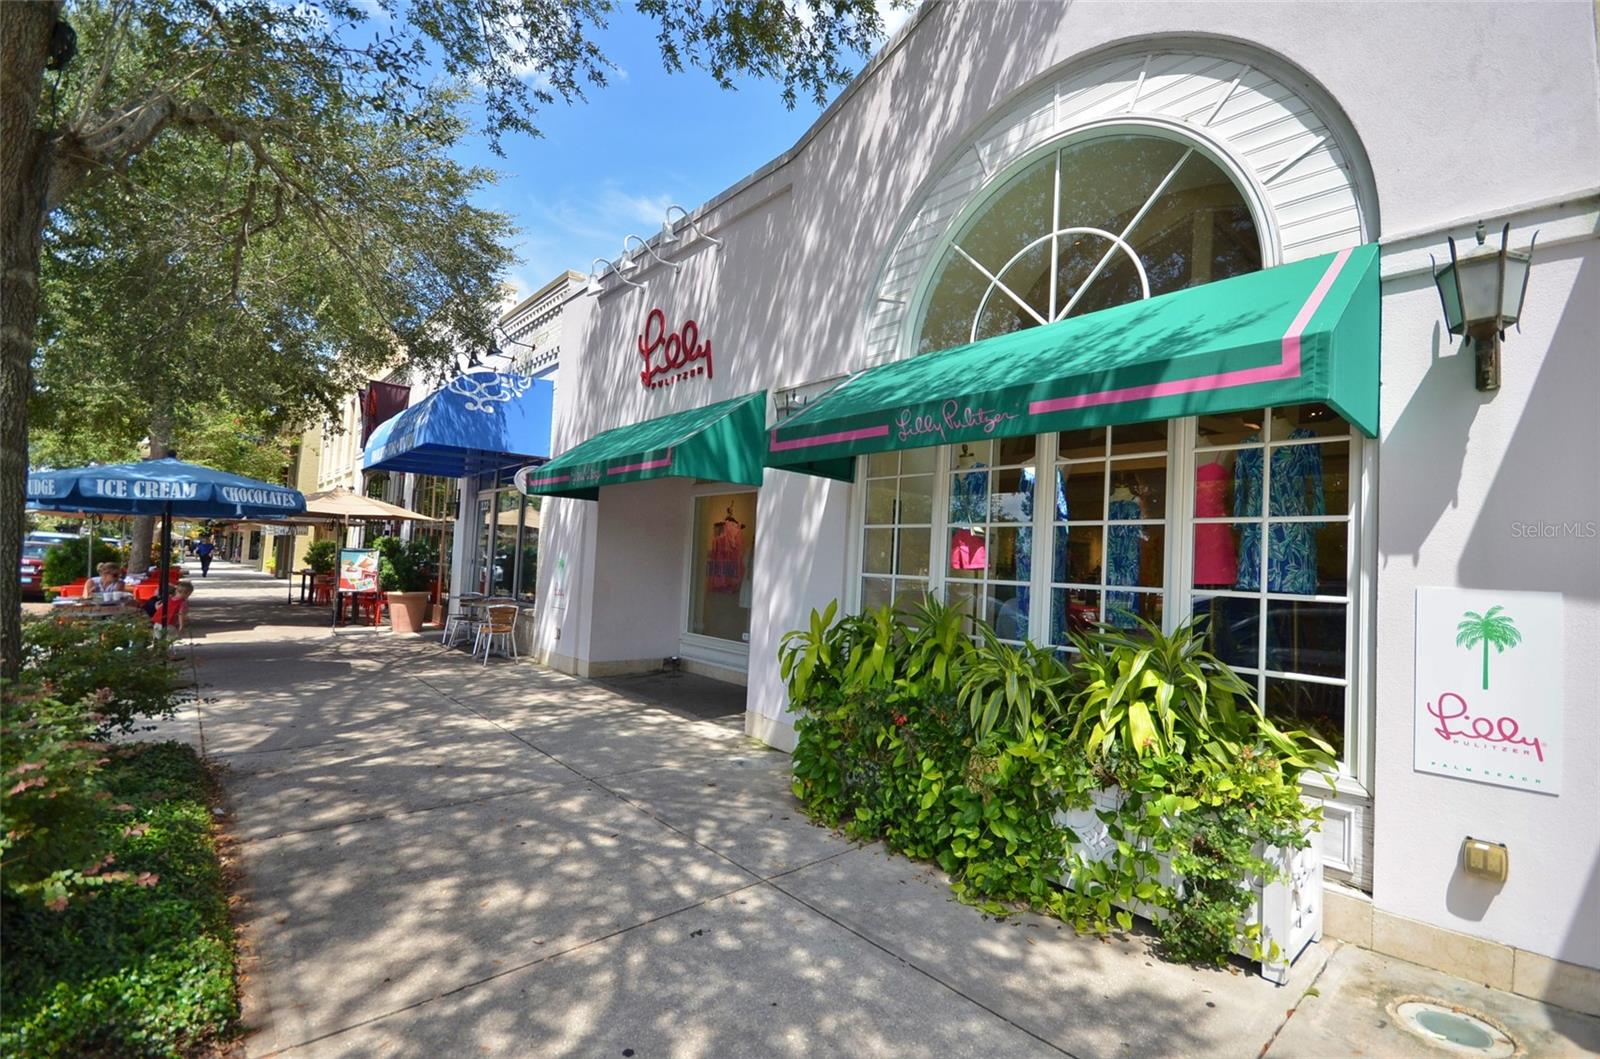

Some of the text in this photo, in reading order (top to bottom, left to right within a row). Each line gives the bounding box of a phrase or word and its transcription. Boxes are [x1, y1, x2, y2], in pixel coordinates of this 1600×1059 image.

[638, 308, 713, 388] Lilly
[651, 366, 704, 390] PULITZER
[895, 399, 1020, 442] Lilly Pulitzer
[27, 479, 56, 496] UDGE
[96, 479, 198, 498] ICE CREAM
[222, 486, 297, 508] CHOCOLATES
[1427, 693, 1544, 763] Lilly
[1453, 739, 1530, 756] PULITZER
